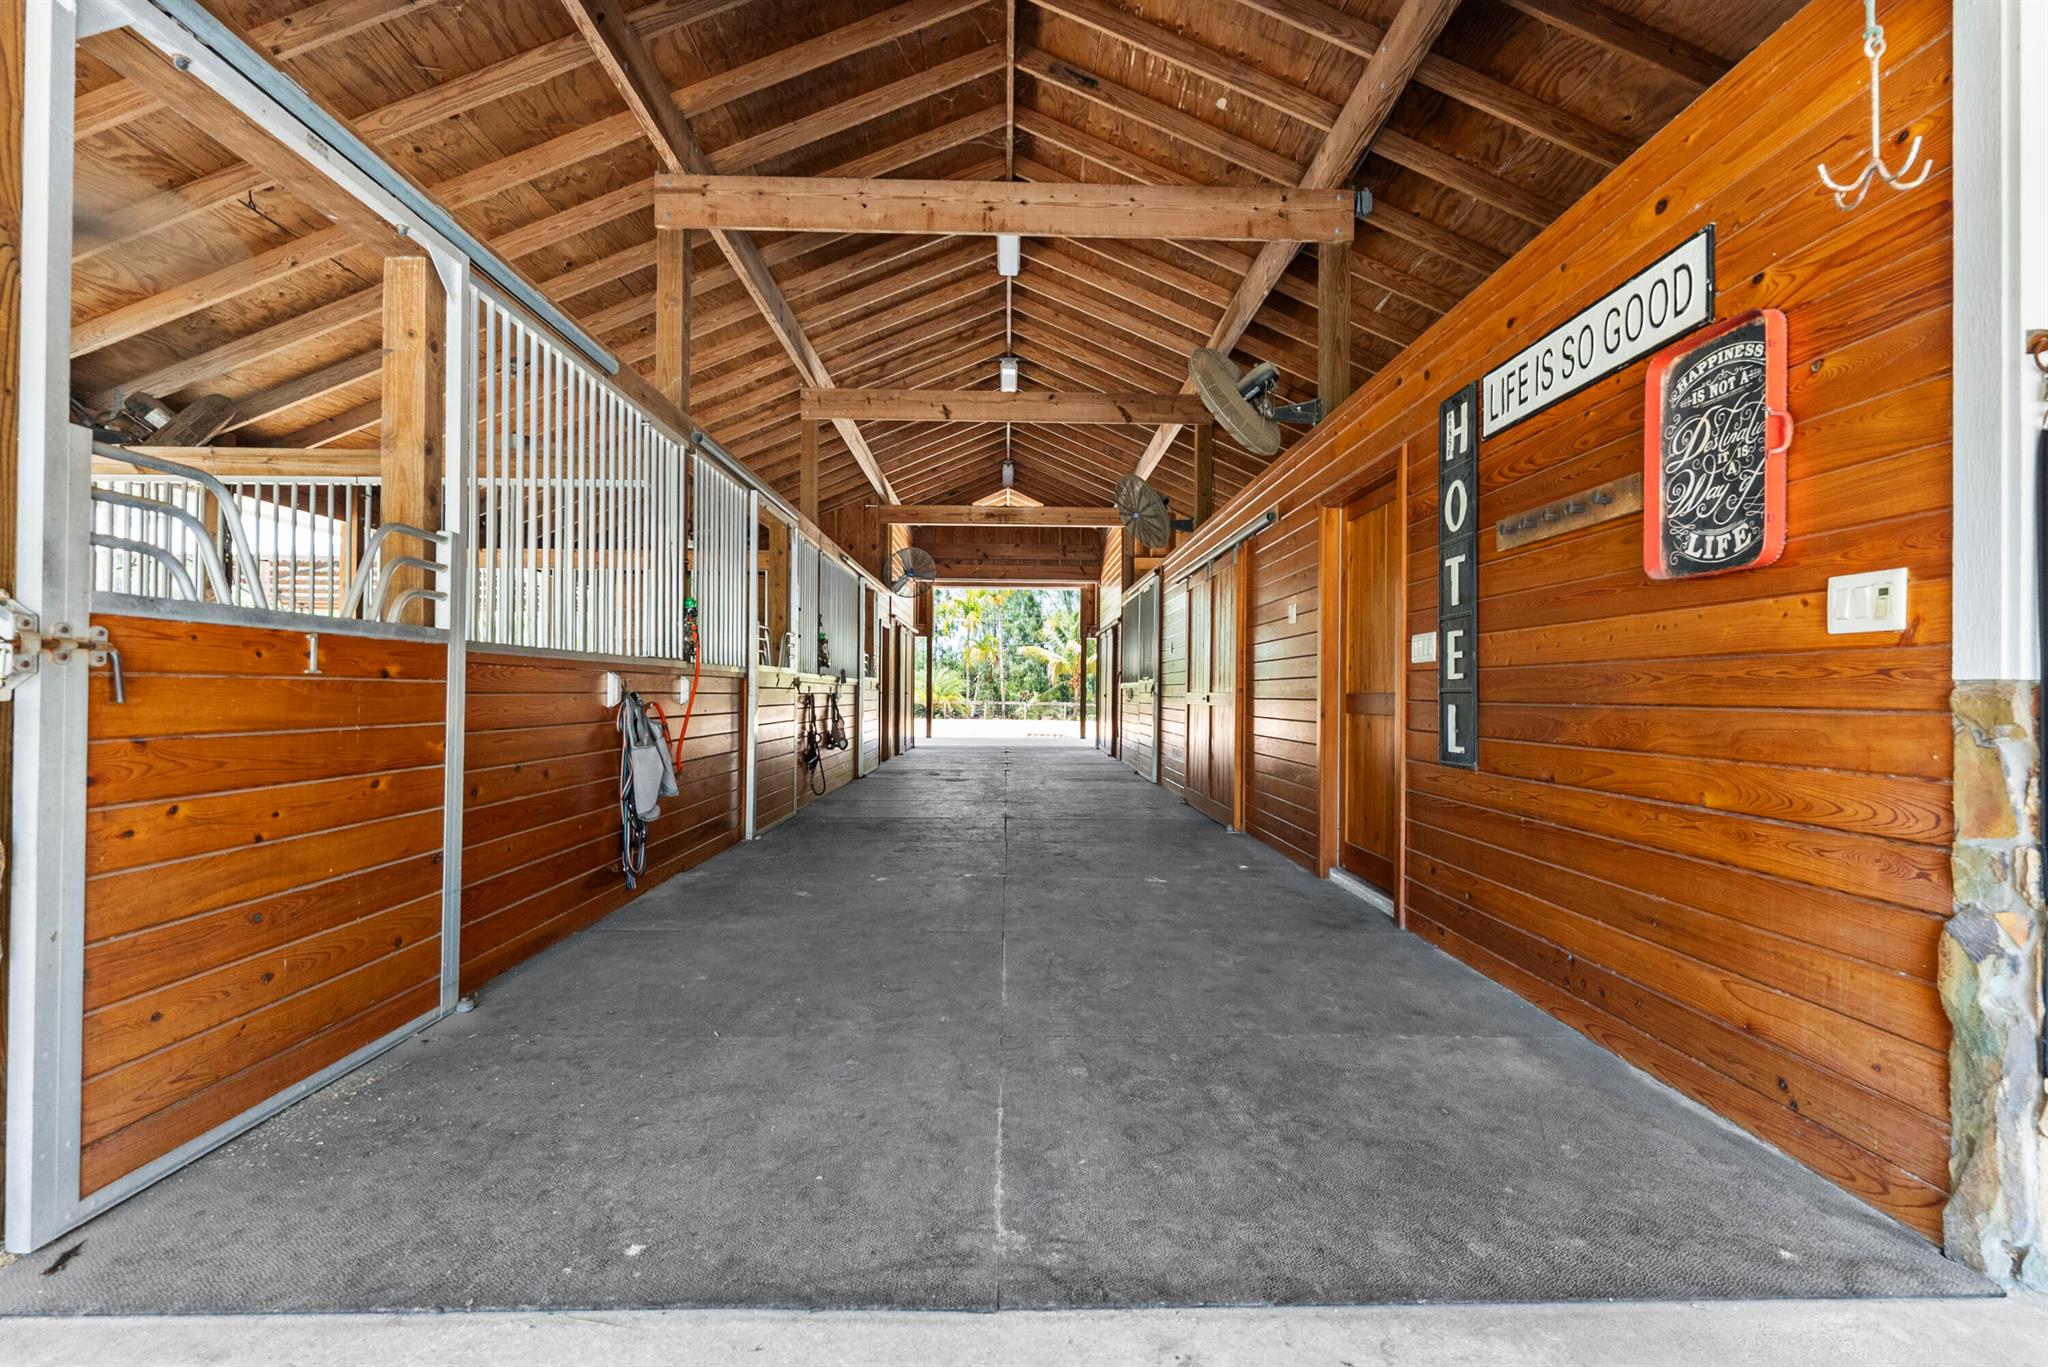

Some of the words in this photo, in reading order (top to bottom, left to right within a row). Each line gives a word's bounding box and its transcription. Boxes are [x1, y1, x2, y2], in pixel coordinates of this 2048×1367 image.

[1490, 361, 1529, 422] LIFE
[1535, 348, 1554, 396] IS
[1562, 324, 1594, 379] SO
[1604, 263, 1693, 354] GOOD
[1676, 343, 1765, 393] HAPPINESS
[1692, 390, 1706, 405] IS
[1709, 376, 1736, 399] NOT
[1740, 370, 1749, 386] A
[1717, 451, 1730, 464] IT
[1737, 444, 1749, 458] IS
[1726, 461, 1737, 476] A
[1666, 455, 1731, 519] Way
[1713, 457, 1765, 525] of
[1684, 522, 1752, 559] LIFE
[1445, 401, 1468, 755] HOTEL
